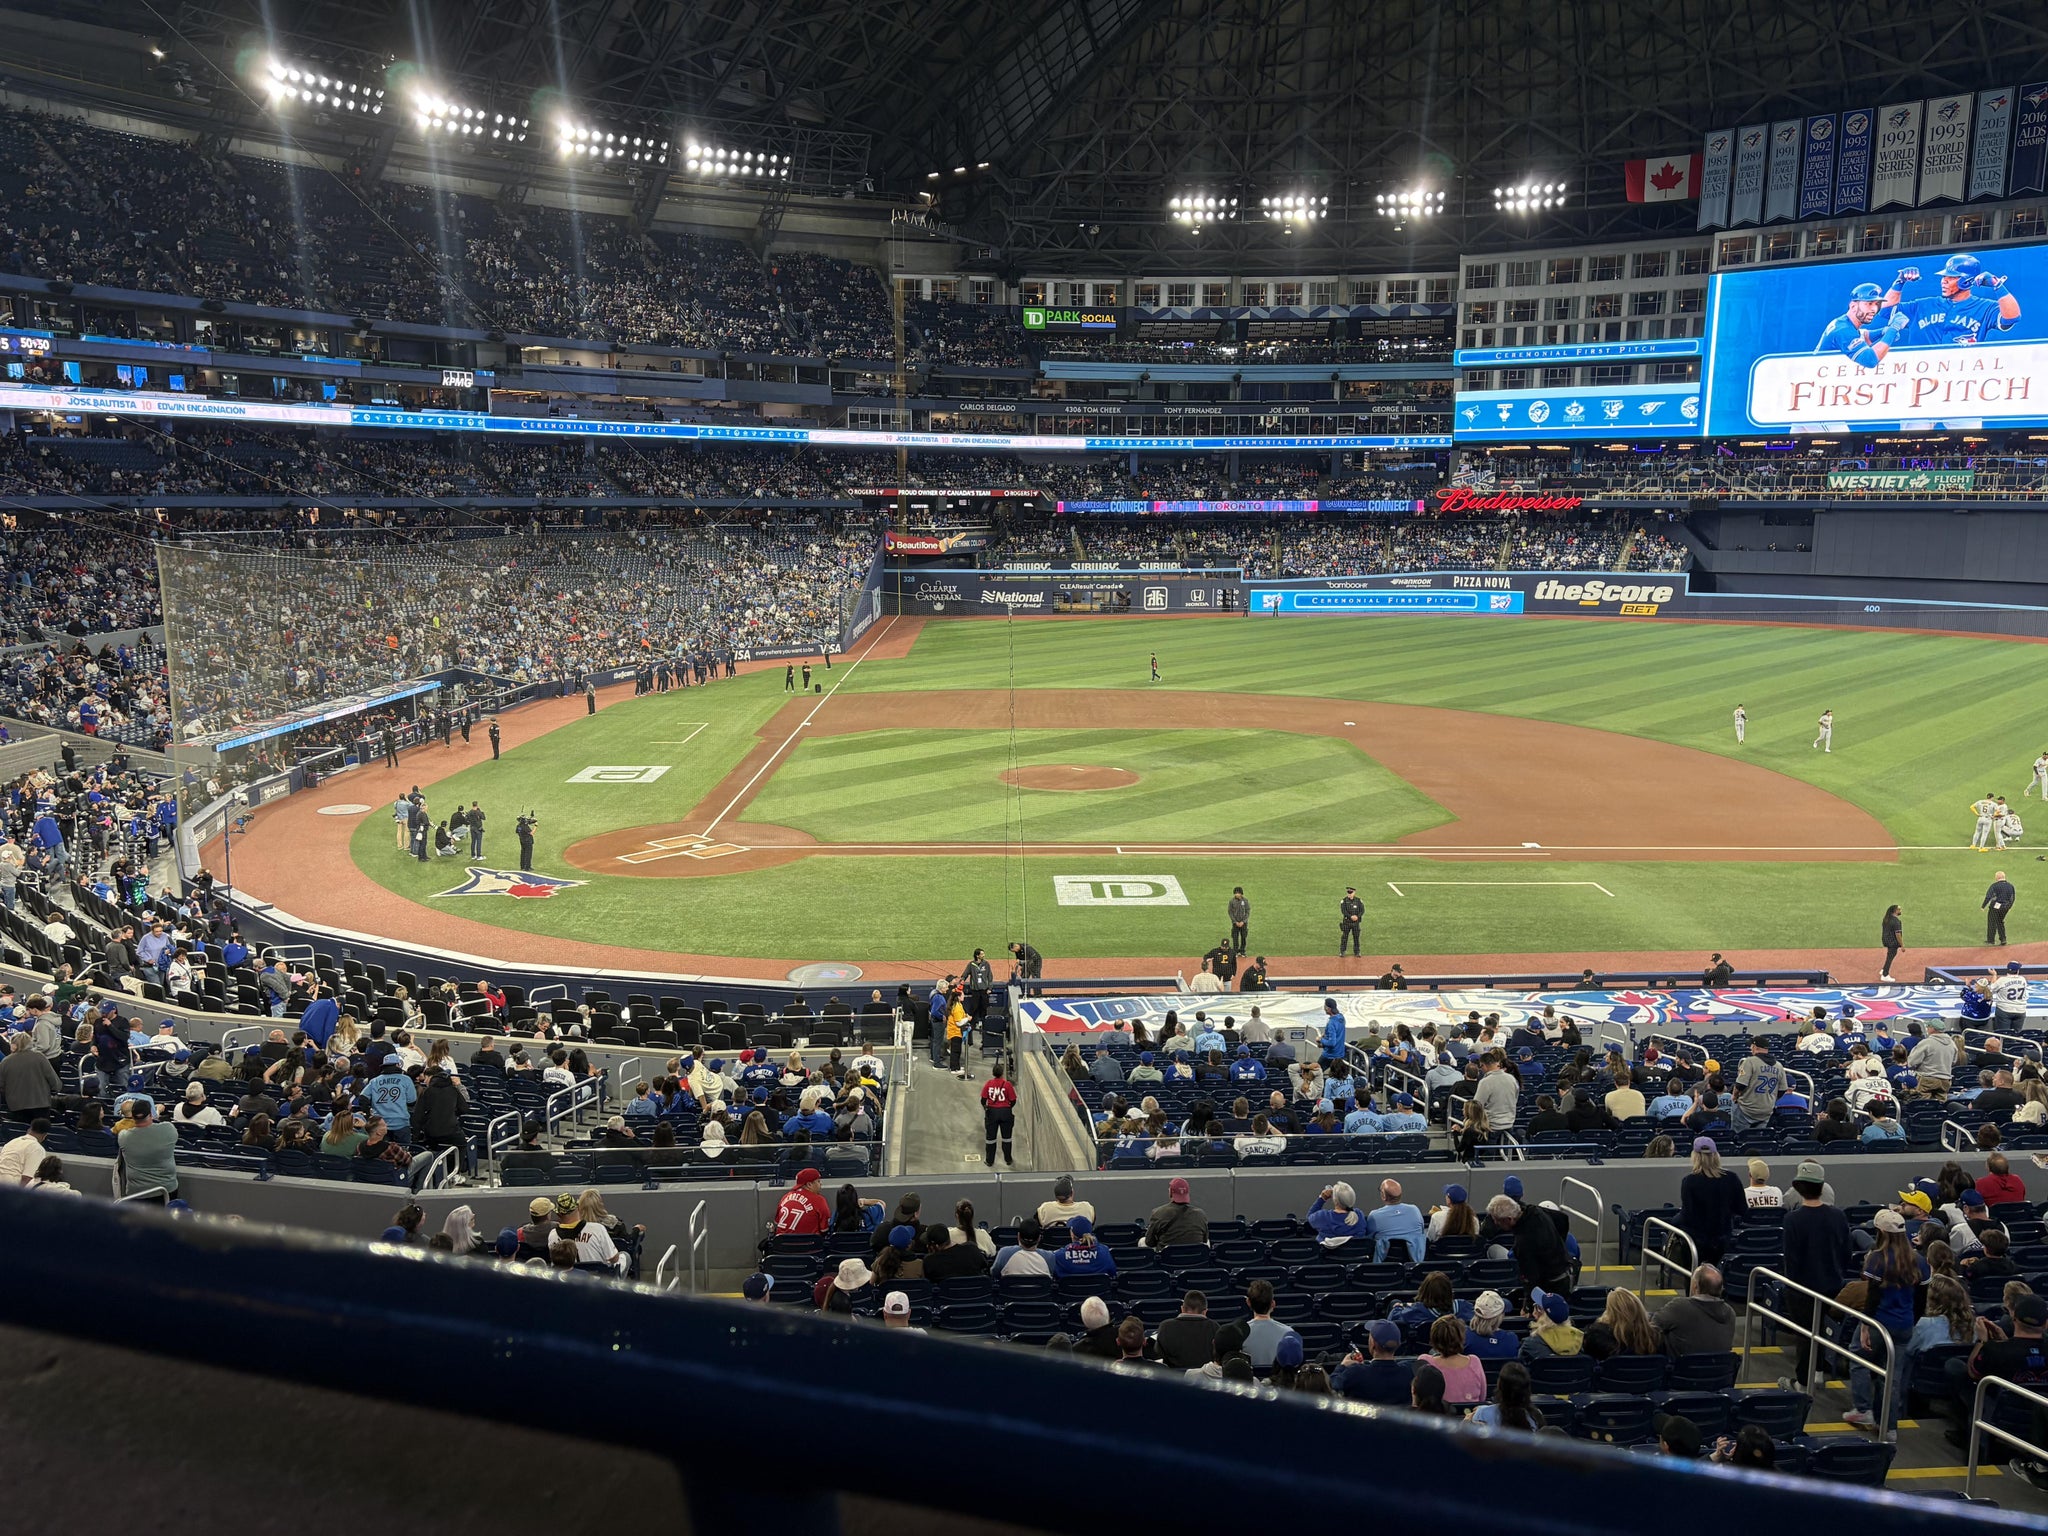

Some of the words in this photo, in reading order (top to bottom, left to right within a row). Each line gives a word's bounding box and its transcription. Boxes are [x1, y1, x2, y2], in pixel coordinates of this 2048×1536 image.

[1981, 116, 2006, 130] 2015
[2021, 111, 2047, 125] 2016
[1930, 122, 1966, 142] 1993
[1979, 131, 2005, 141] AMERICAN
[2019, 124, 2047, 139] ALDS
[1844, 135, 1867, 149] 1993
[1881, 129, 1915, 148] 1992
[1978, 138, 2004, 148] LEAGUE
[2017, 136, 2046, 148] CHAMPS
[1775, 146, 1795, 159] 1991
[1809, 141, 1831, 154] 1992
[1927, 141, 1965, 156] WORLD
[1977, 147, 2003, 157] EAST
[1740, 151, 1762, 163] 1989
[1807, 155, 1831, 163] AMERICAN
[1842, 150, 1867, 158] AMERICAN
[1879, 148, 1915, 162] WORLD
[1707, 155, 1728, 168] 1985
[1773, 159, 1796, 168] AMERICAN
[1806, 161, 1830, 170] LEAGUE
[1841, 156, 1867, 165] LEAGUE
[1925, 153, 1964, 168] SERIES
[1975, 156, 2003, 166] CHAMPS
[1705, 168, 1728, 176] AMERICAN
[1738, 164, 1761, 172] AMERICAN
[1772, 165, 1794, 176] LEAGUE
[1840, 163, 1865, 175] EAST
[1877, 159, 1914, 174] SERIES
[1924, 164, 1963, 176] CHAMPIONS
[1704, 175, 1727, 184] LEAGUE
[1737, 170, 1761, 180] LEAGUE
[1771, 173, 1793, 186] EAST
[1805, 168, 1830, 180] EAST
[1839, 173, 1864, 183] CHAMPS
[1876, 170, 1913, 182] CHAMPIONS
[1975, 169, 2001, 182] ALDS
[1737, 178, 1760, 190] EAST
[1770, 183, 1794, 192] CHAMPS
[1804, 177, 1829, 187] CHAMPS
[1973, 179, 2001, 190] CHAMPS
[1704, 183, 1727, 194] EAST
[1736, 187, 1760, 196] CHAMPS
[1839, 185, 1864, 198] ALCS
[1703, 191, 1726, 200] CHAMPS
[1803, 189, 1828, 201] ALCS
[1837, 195, 1863, 205] CHAMPS
[1802, 200, 1827, 209] CHAMPS
[1025, 311, 1044, 325] TD
[1046, 310, 1080, 322] PARK
[1081, 314, 1117, 323] SOCIAL
[1918, 312, 1946, 330] BLUE
[1950, 312, 1981, 333] JAYS
[1495, 349, 1568, 360] CEREMONIAL
[1576, 347, 1611, 356] FIRST
[1619, 345, 1657, 354] PITCH
[1816, 357, 2005, 378] CEREMONIAL
[1788, 381, 1897, 412] FIRST
[1908, 376, 2032, 409] PITCH
[50, 395, 62, 406] 19
[93, 398, 137, 409] BAUTISTA
[141, 400, 152, 410] 10
[157, 402, 185, 412] EDWIN
[959, 403, 985, 411] CARLOS
[986, 404, 1016, 412] DELGADO
[1371, 405, 1400, 413] GEORGE
[1402, 405, 1418, 413] BELL
[1064, 406, 1082, 414] 4306
[1083, 406, 1098, 414] TOM
[1099, 406, 1121, 414] CHEEK
[1268, 406, 1282, 414] JOE
[1284, 406, 1310, 414] CARTER
[521, 420, 590, 431] CEREMONIAL
[597, 424, 627, 433] FIRST
[634, 425, 667, 434] PITCH
[1934, 475, 1972, 483] FLIGHT
[1436, 487, 1583, 512] Budweiser
[1110, 501, 1148, 512] CONNECT
[1368, 500, 1411, 511] CONNECT
[1003, 562, 1052, 571] SUBWAY
[1071, 562, 1120, 570] SUBWAY
[903, 575, 915, 583] 328
[1453, 576, 1482, 589] PIZZA
[1484, 576, 1511, 590] NOVA
[920, 582, 958, 593] CLEARLY
[1534, 579, 1674, 603] theScore
[915, 592, 962, 601] CANADIAN
[1311, 597, 1380, 605] CEREMONIAL
[1623, 605, 1658, 614] BET
[1863, 604, 1881, 613] 400
[1067, 880, 1168, 899] TD
[2006, 987, 2025, 1000] 27
[1760, 1065, 1779, 1074] CARTER
[378, 1077, 401, 1086] CARTER
[1754, 1075, 1778, 1094] 29
[376, 1086, 401, 1104] 29
[988, 1086, 1006, 1102] EMS
[1747, 1196, 1778, 1208] SKENES
[777, 1206, 805, 1231] 27
[1065, 1249, 1098, 1260] REIGN
